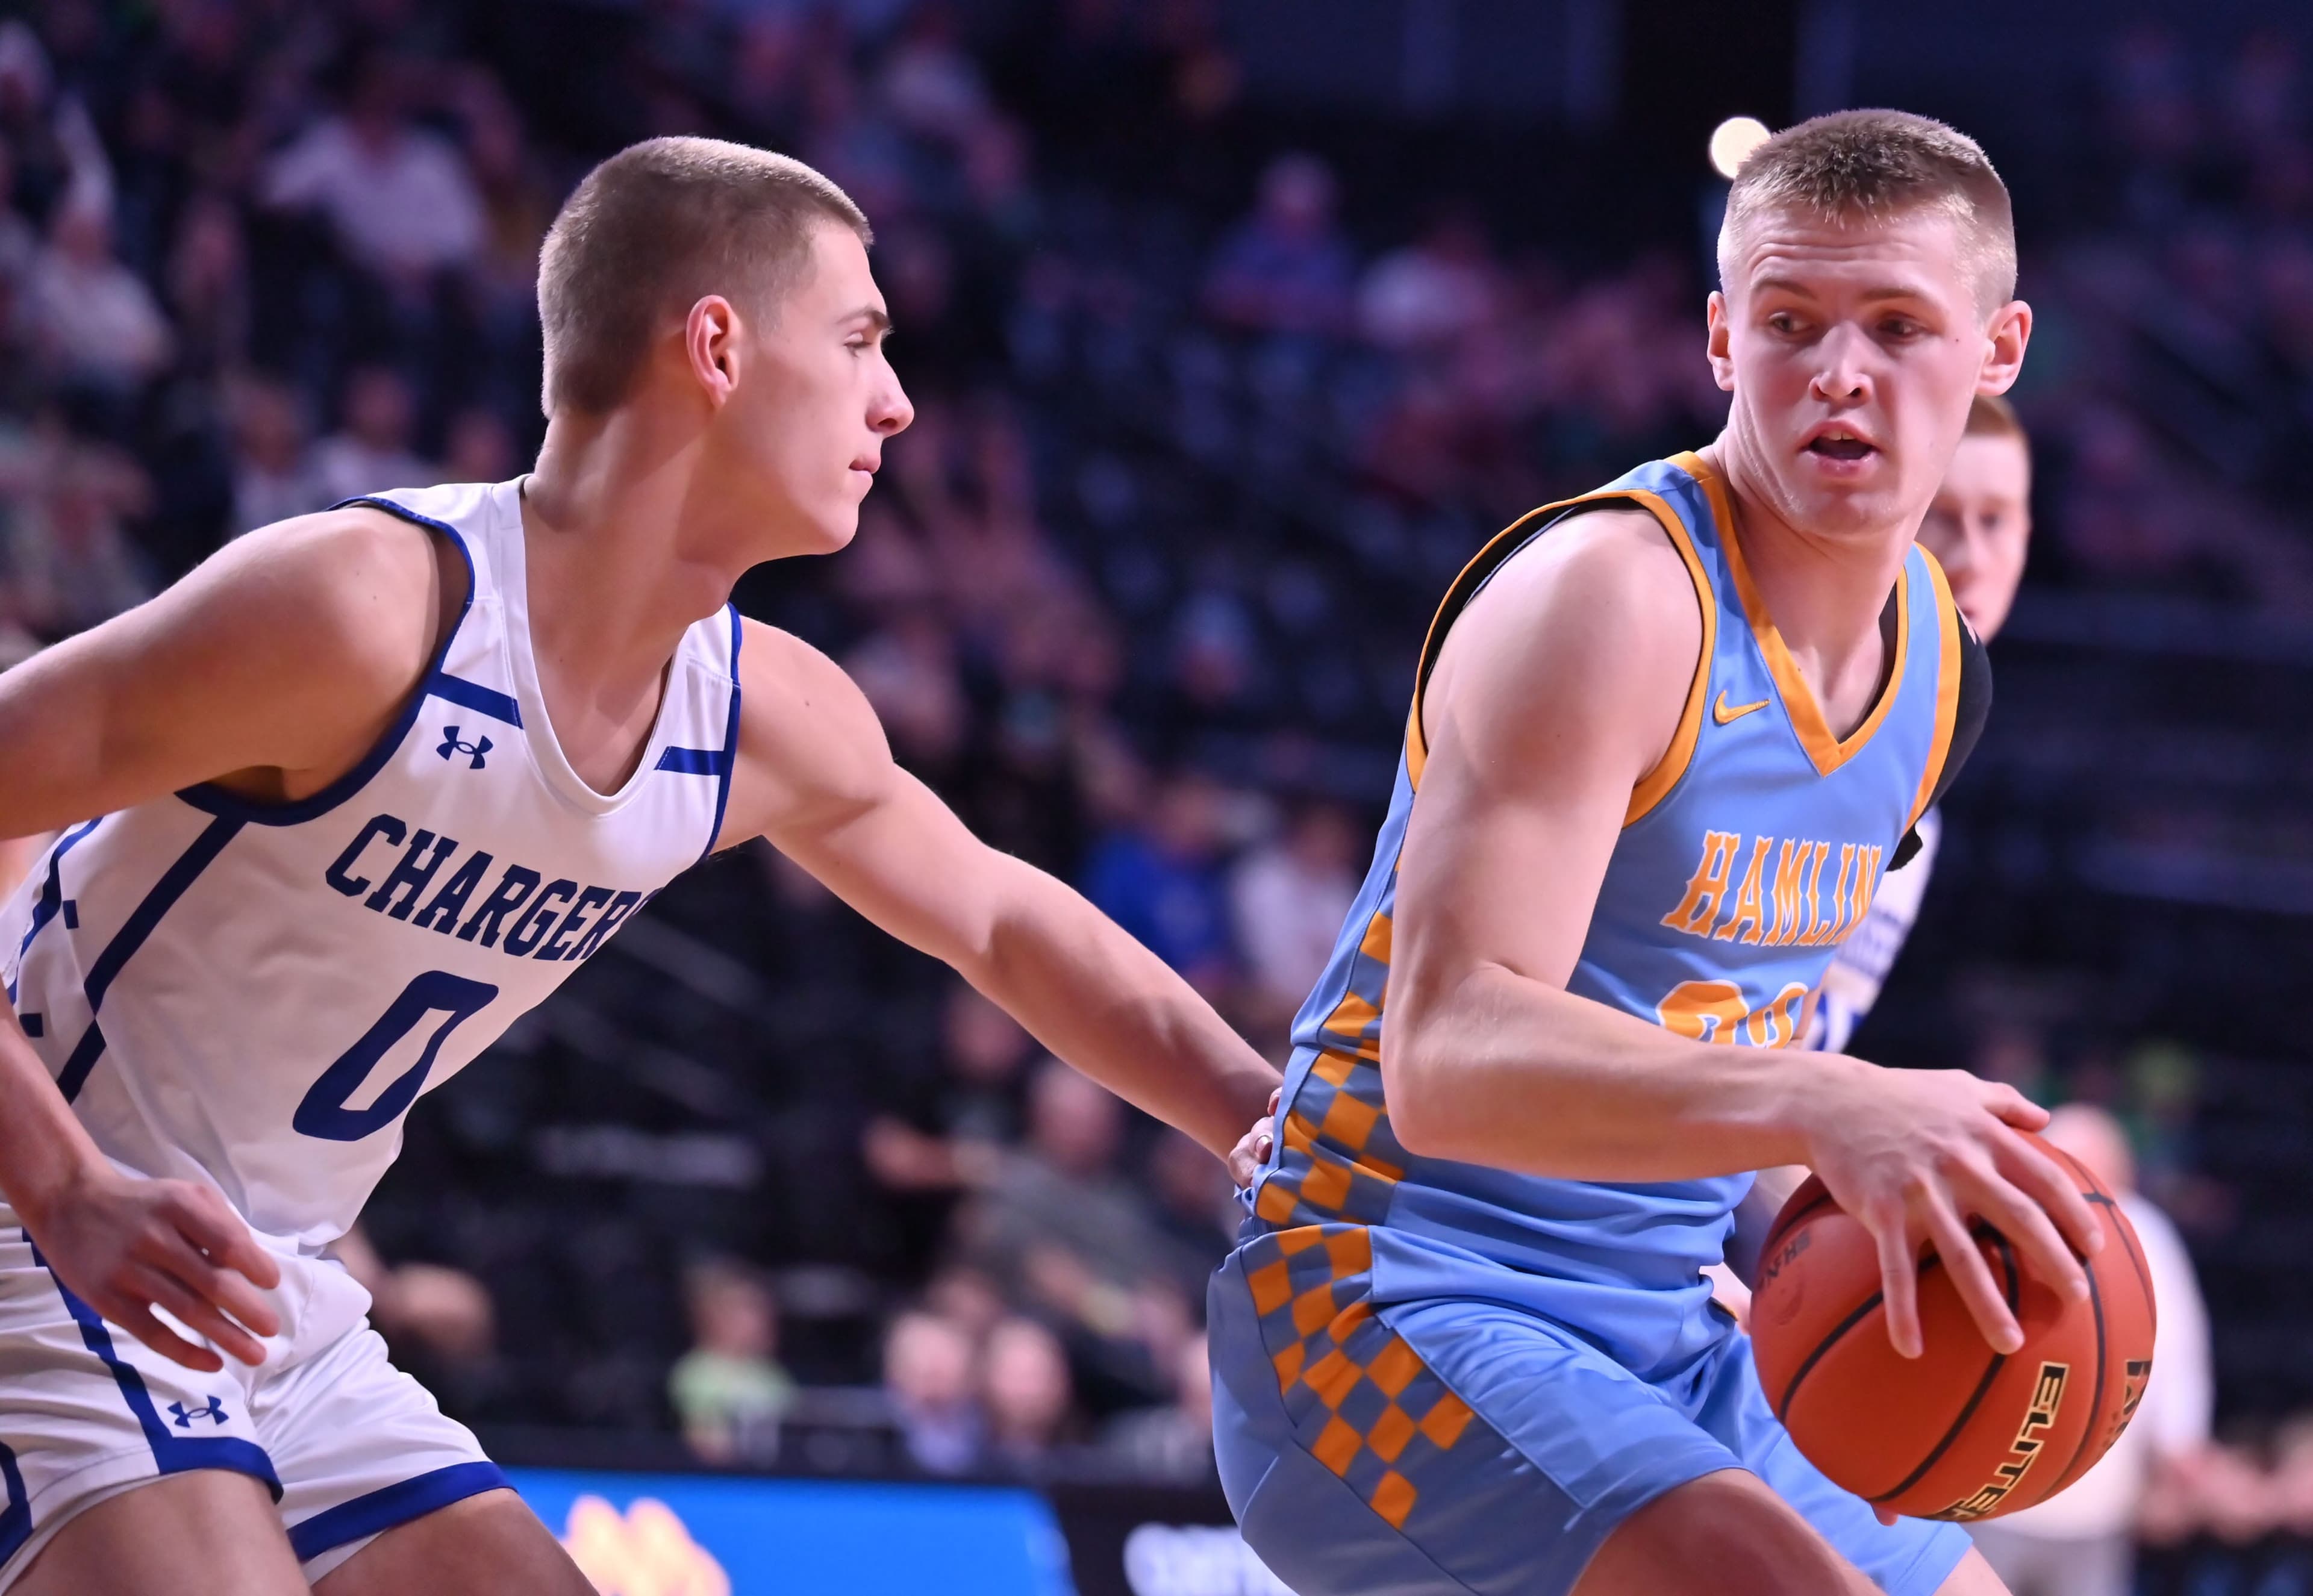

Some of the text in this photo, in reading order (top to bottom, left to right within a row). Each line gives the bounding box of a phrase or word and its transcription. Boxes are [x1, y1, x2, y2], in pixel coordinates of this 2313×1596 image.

[325, 814, 664, 962] CHARGER
[1660, 829, 1882, 947] HAMLIN
[293, 970, 499, 1141] 0
[1959, 1361, 2070, 1512] ELITE
